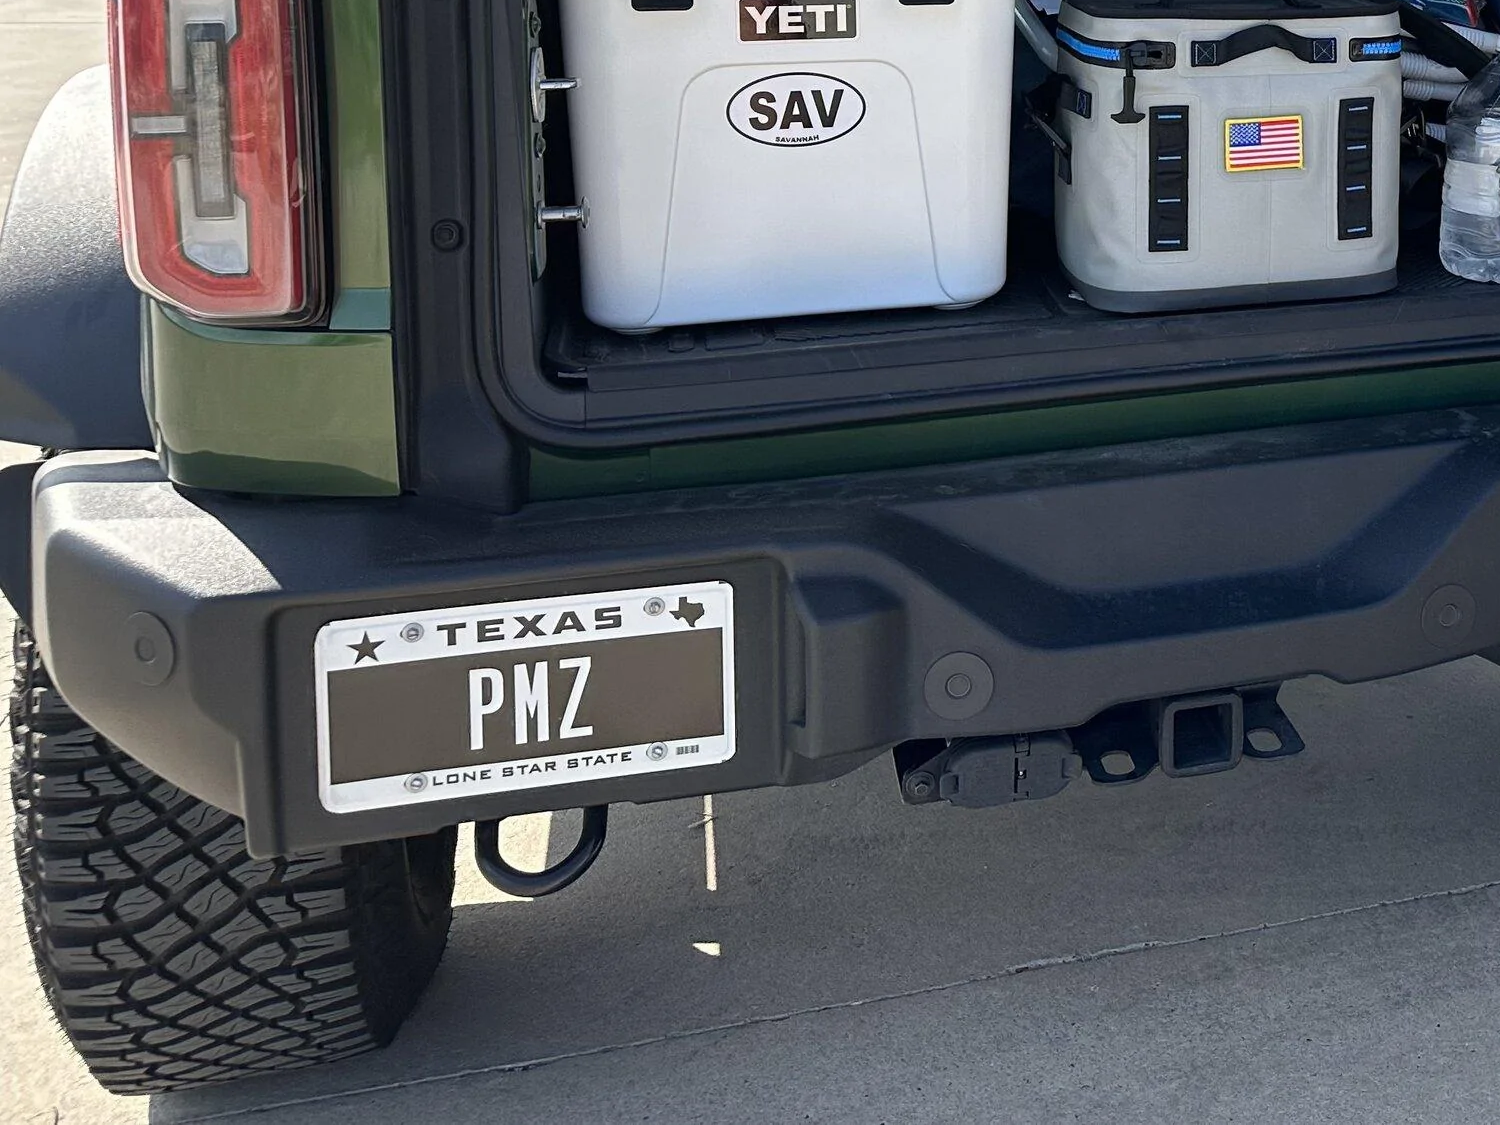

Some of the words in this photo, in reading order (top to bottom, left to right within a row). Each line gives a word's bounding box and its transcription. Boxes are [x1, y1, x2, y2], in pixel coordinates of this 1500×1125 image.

[745, 4, 847, 34] YETI
[749, 89, 844, 131] SAV
[775, 134, 820, 143] SAVANNAH
[437, 606, 622, 646] TEXAS
[468, 655, 594, 751] PMZ
[432, 767, 492, 787] LONE
[502, 758, 557, 778] STAR
[567, 750, 633, 770] STATE
